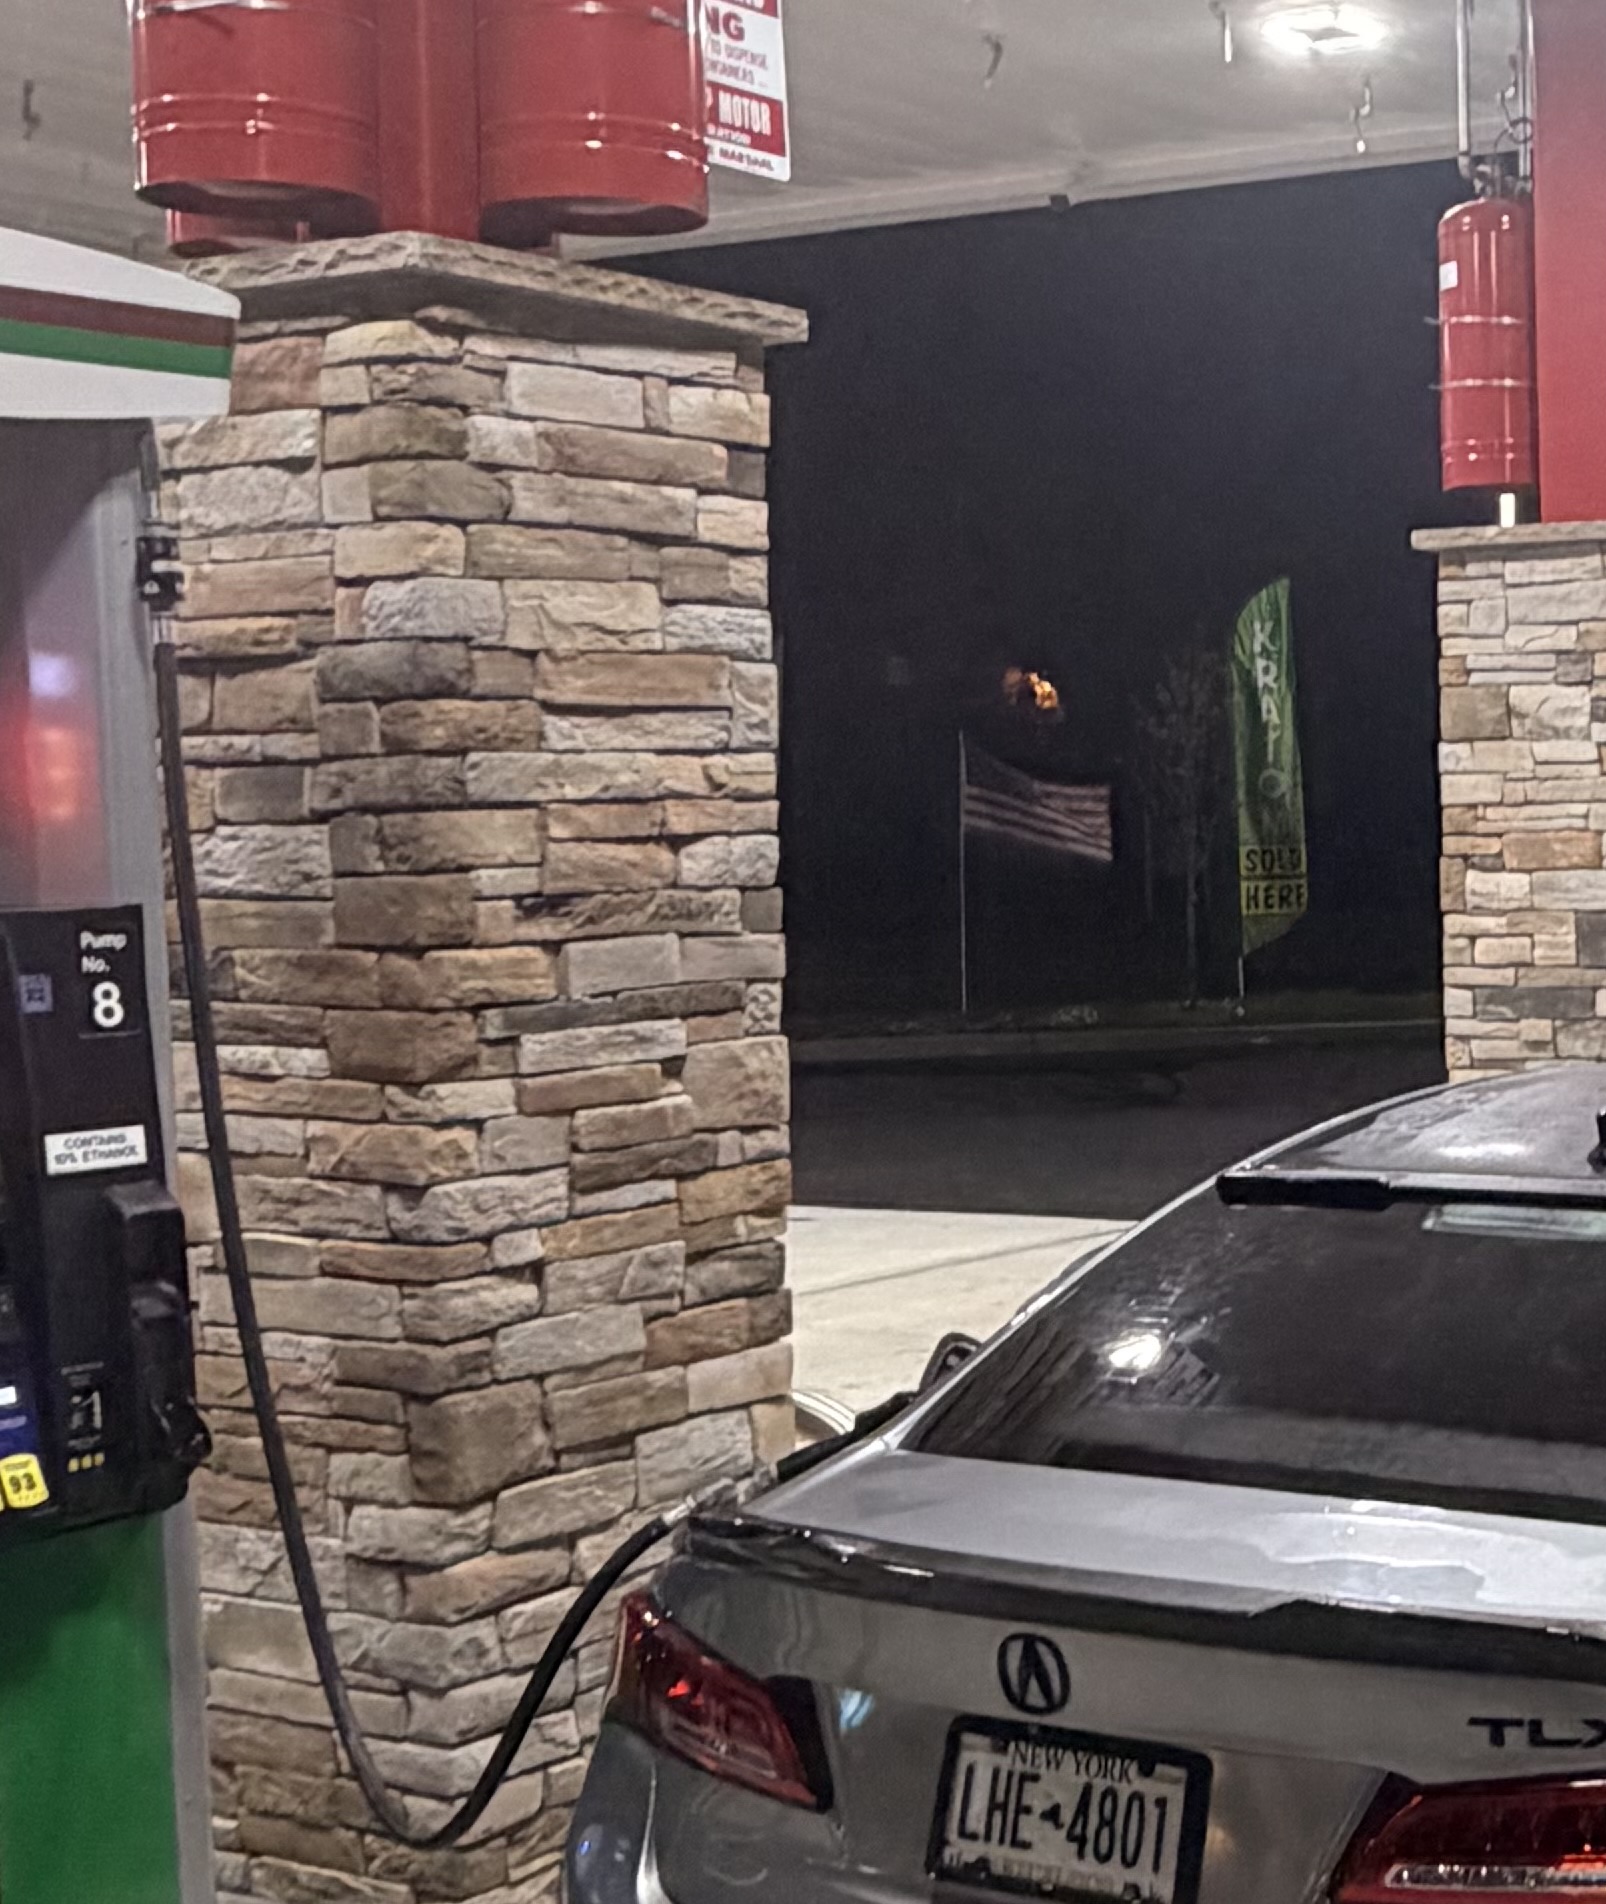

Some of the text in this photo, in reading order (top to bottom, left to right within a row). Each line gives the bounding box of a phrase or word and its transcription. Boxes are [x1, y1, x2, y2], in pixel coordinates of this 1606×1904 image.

[704, 3, 745, 42] NG
[719, 89, 771, 137] MOTOR
[1246, 883, 1305, 910] HERE
[80, 931, 128, 951] Pump
[82, 955, 111, 973] No.
[93, 981, 124, 1027] 8
[9, 1472, 36, 1494] 93
[1010, 1741, 1134, 1784] NEW YORK
[957, 1762, 1168, 1875] LHE 4801
